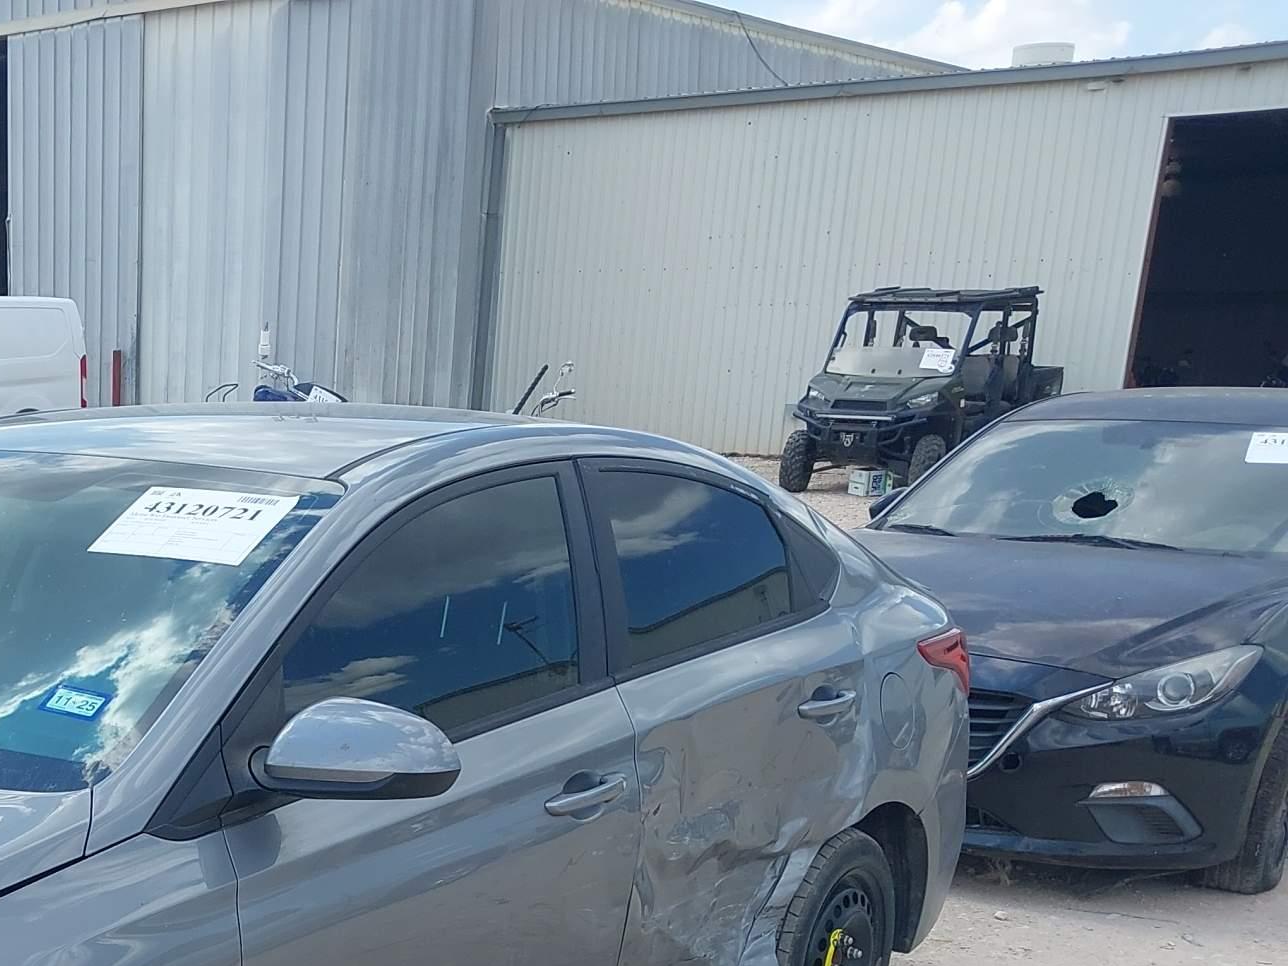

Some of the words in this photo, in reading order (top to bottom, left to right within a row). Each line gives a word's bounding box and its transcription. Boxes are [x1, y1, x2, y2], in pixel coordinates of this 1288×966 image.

[144, 500, 263, 521] 43120721
[55, 695, 72, 706] 11
[76, 700, 97, 711] 25
